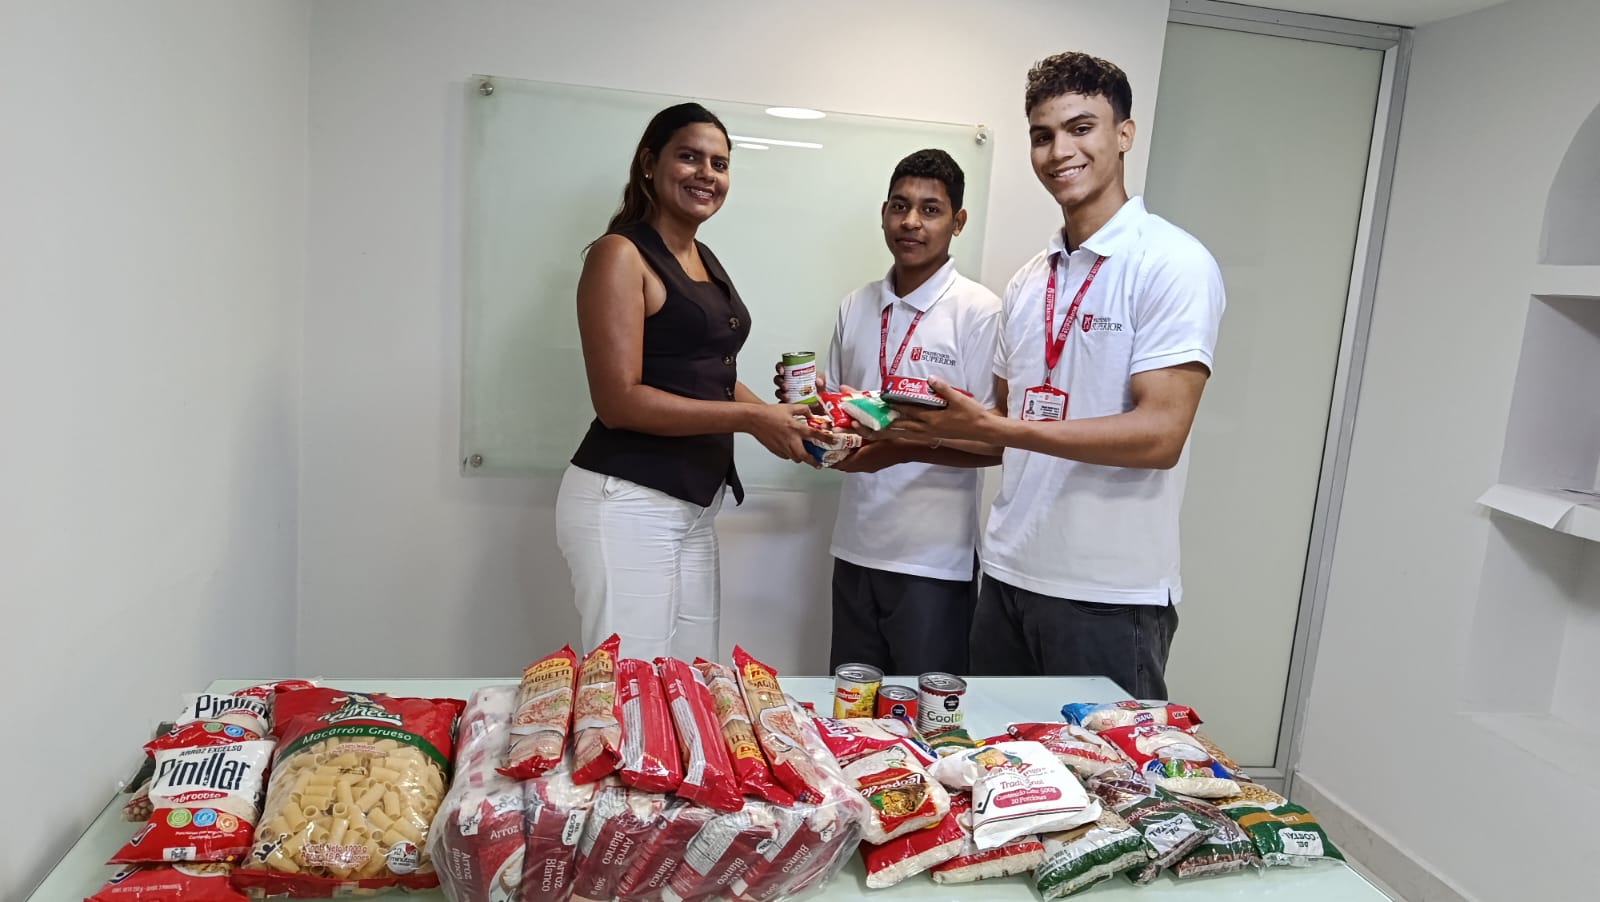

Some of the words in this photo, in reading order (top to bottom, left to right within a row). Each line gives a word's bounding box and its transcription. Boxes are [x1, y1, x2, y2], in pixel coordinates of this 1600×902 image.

[207, 745, 243, 753] EXCELSO
[302, 726, 364, 745] Macarrón
[368, 727, 412, 741] Grueso
[157, 753, 251, 790] Pinillar
[490, 825, 520, 840] Arroz
[602, 831, 625, 865] Blanco
[614, 837, 635, 865] Arroz
[782, 844, 809, 873] Blanco
[461, 852, 472, 880] Arroz
[542, 858, 556, 892] Blanco
[555, 860, 567, 890] Arroz
[648, 857, 675, 888] Blanco
[716, 857, 745, 885] Blanco
